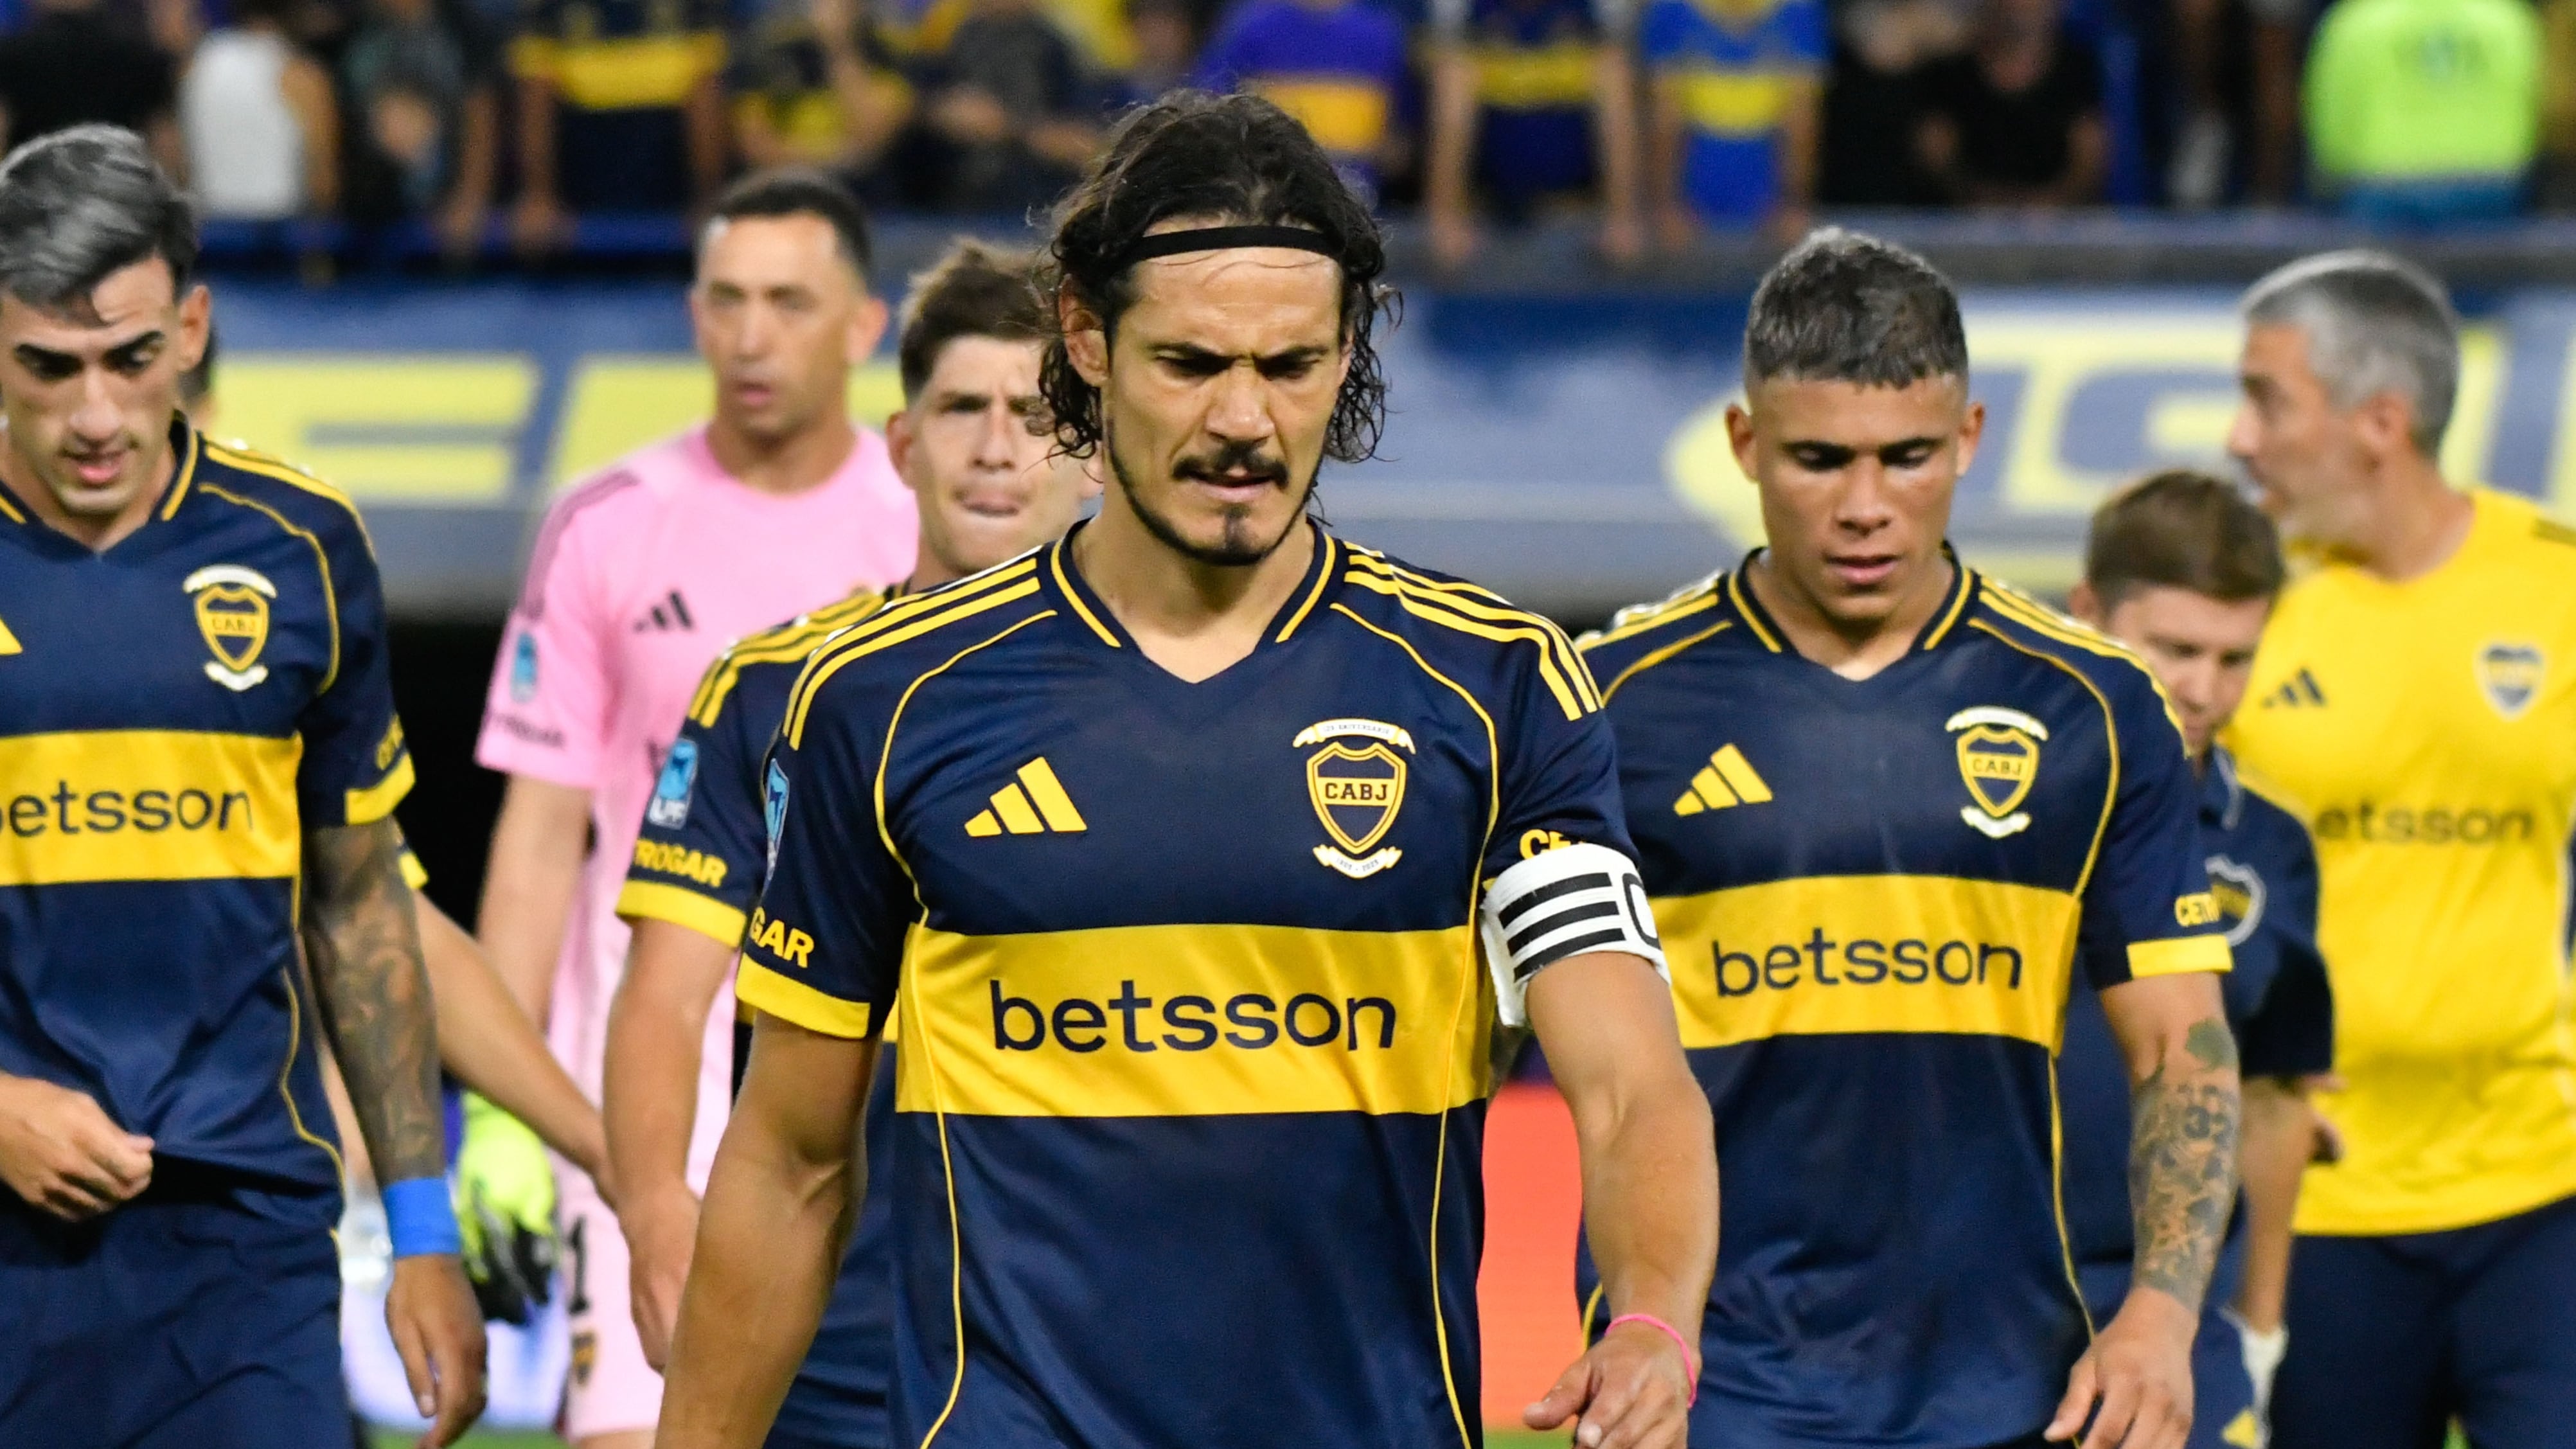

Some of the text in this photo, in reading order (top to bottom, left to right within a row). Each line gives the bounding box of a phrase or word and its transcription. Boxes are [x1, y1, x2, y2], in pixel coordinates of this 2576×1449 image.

[1325, 782, 1389, 801] CABJ
[1973, 758, 2022, 776] CABJ
[0, 779, 253, 837] etsson
[1711, 927, 2023, 999] betsson
[990, 979, 1397, 1053] betsson
